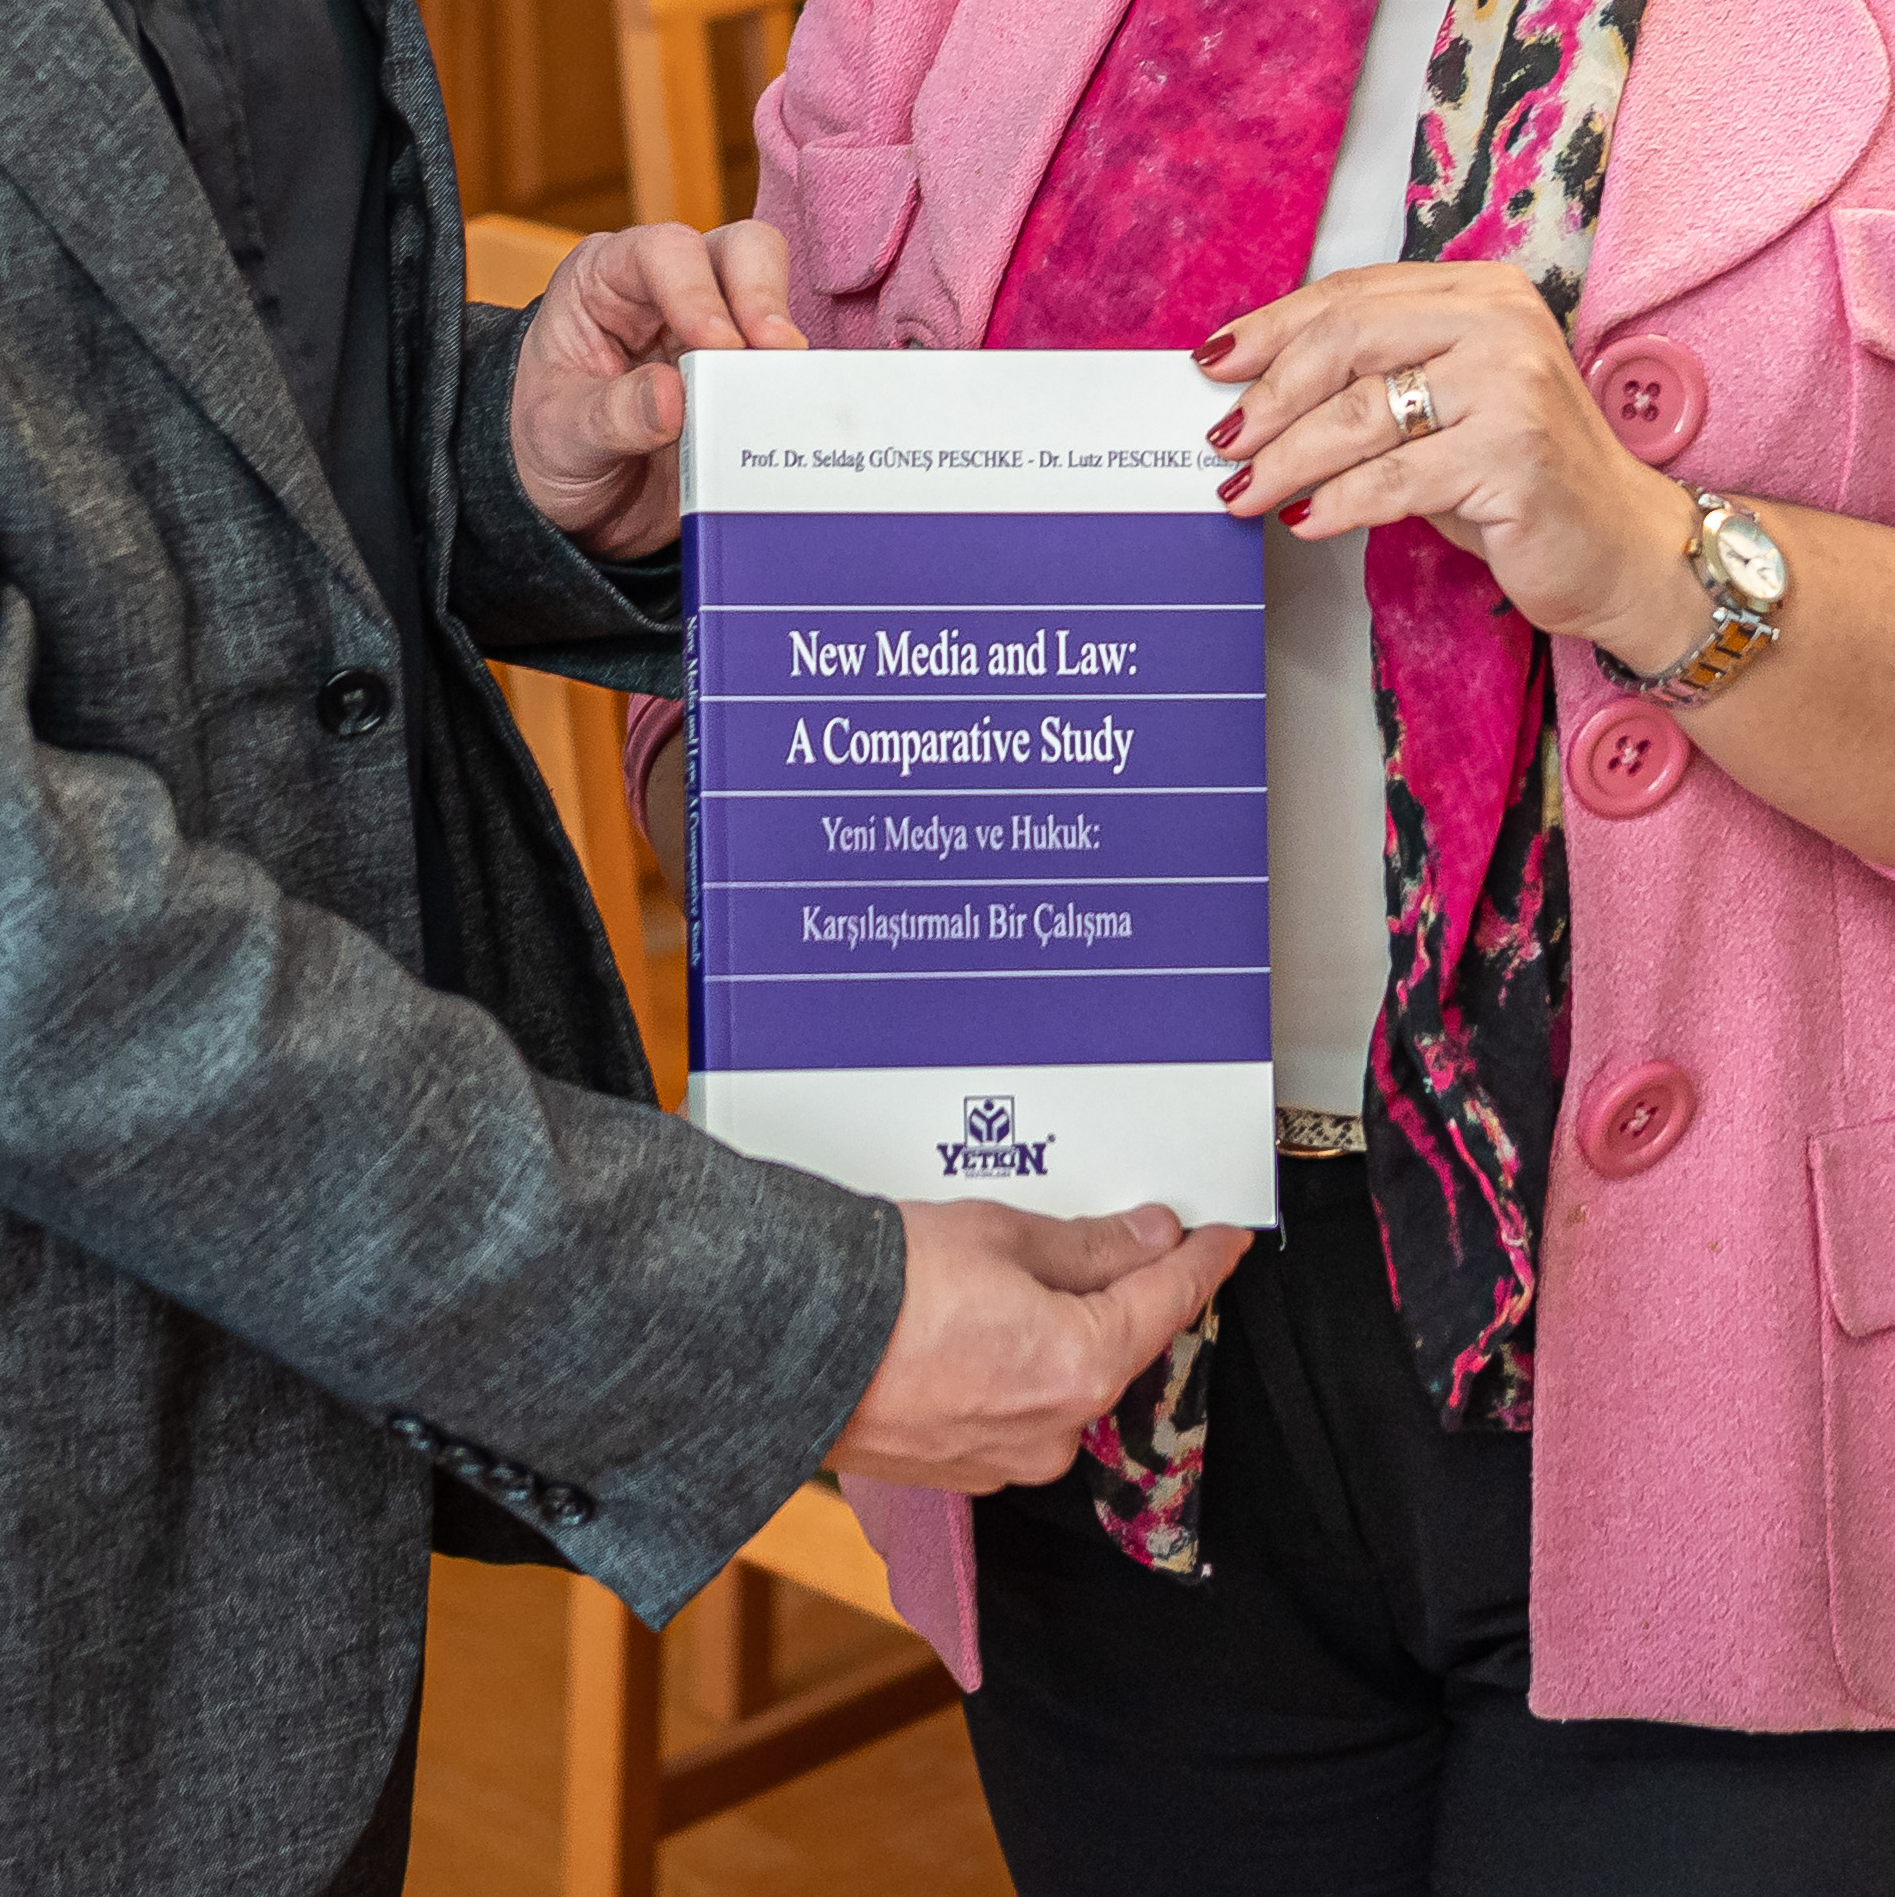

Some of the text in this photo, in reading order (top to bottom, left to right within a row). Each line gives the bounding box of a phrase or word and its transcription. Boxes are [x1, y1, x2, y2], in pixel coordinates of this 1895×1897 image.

[740, 448, 779, 468] Prof.
[783, 449, 808, 469] Dr.
[812, 448, 866, 473] Seldağ
[868, 446, 934, 473] GÜNEŞ
[937, 449, 1024, 469] PESCHKE
[1038, 450, 1063, 469] Dr.
[1067, 449, 1104, 469] Lutz
[1106, 449, 1193, 469] PESCHKE
[788, 628, 1137, 678] New Media and Law:
[785, 714, 1135, 778] A Comparative Study
[821, 813, 1100, 861] Yeni Medya ve Hukuk:
[802, 901, 1133, 951] Karşılaştırmalı Bir Çalışma
